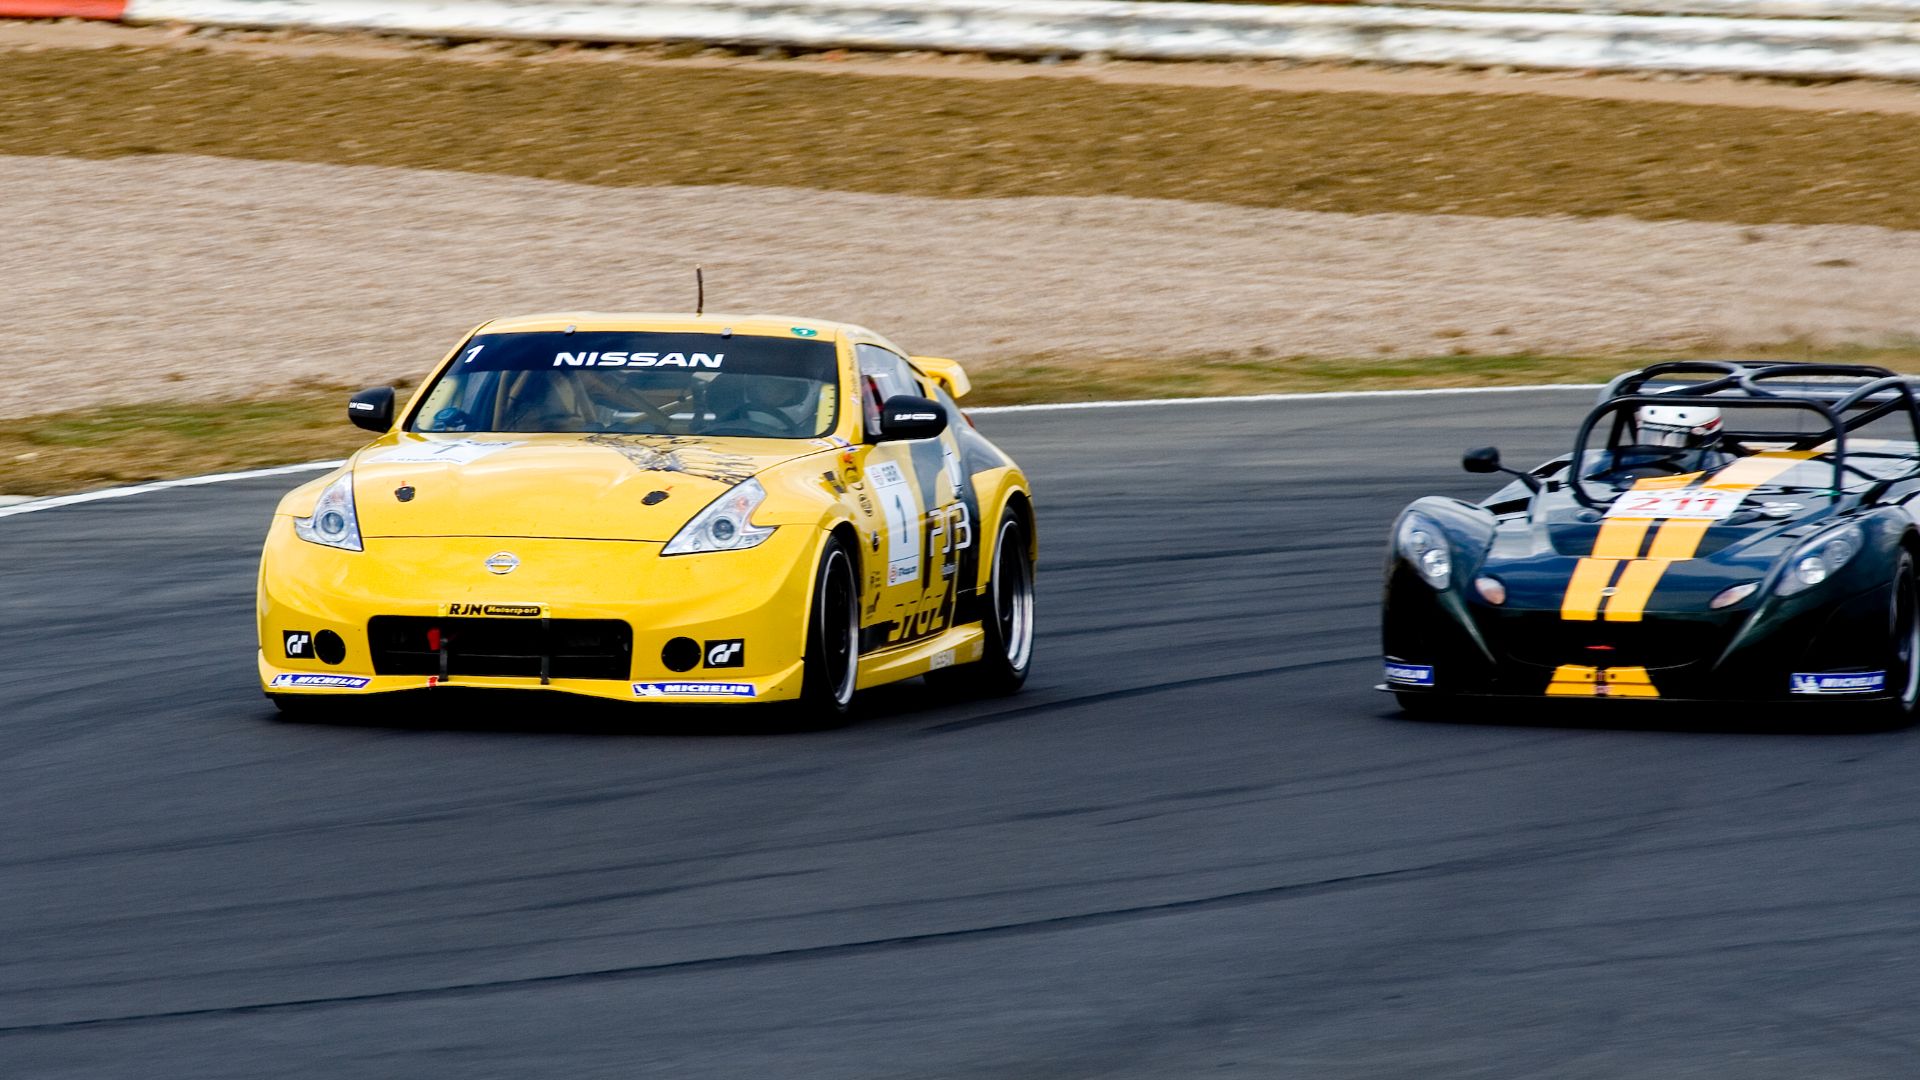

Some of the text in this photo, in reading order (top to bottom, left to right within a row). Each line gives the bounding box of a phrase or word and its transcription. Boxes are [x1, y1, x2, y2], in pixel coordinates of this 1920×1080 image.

[464, 344, 485, 363] 1
[552, 352, 724, 368] NISSAN
[1625, 497, 1719, 512] 211
[894, 494, 908, 544] 1
[449, 603, 538, 616] RJN Motorsport
[295, 676, 367, 686] MICHELIN
[663, 684, 750, 693] MICHELIN
